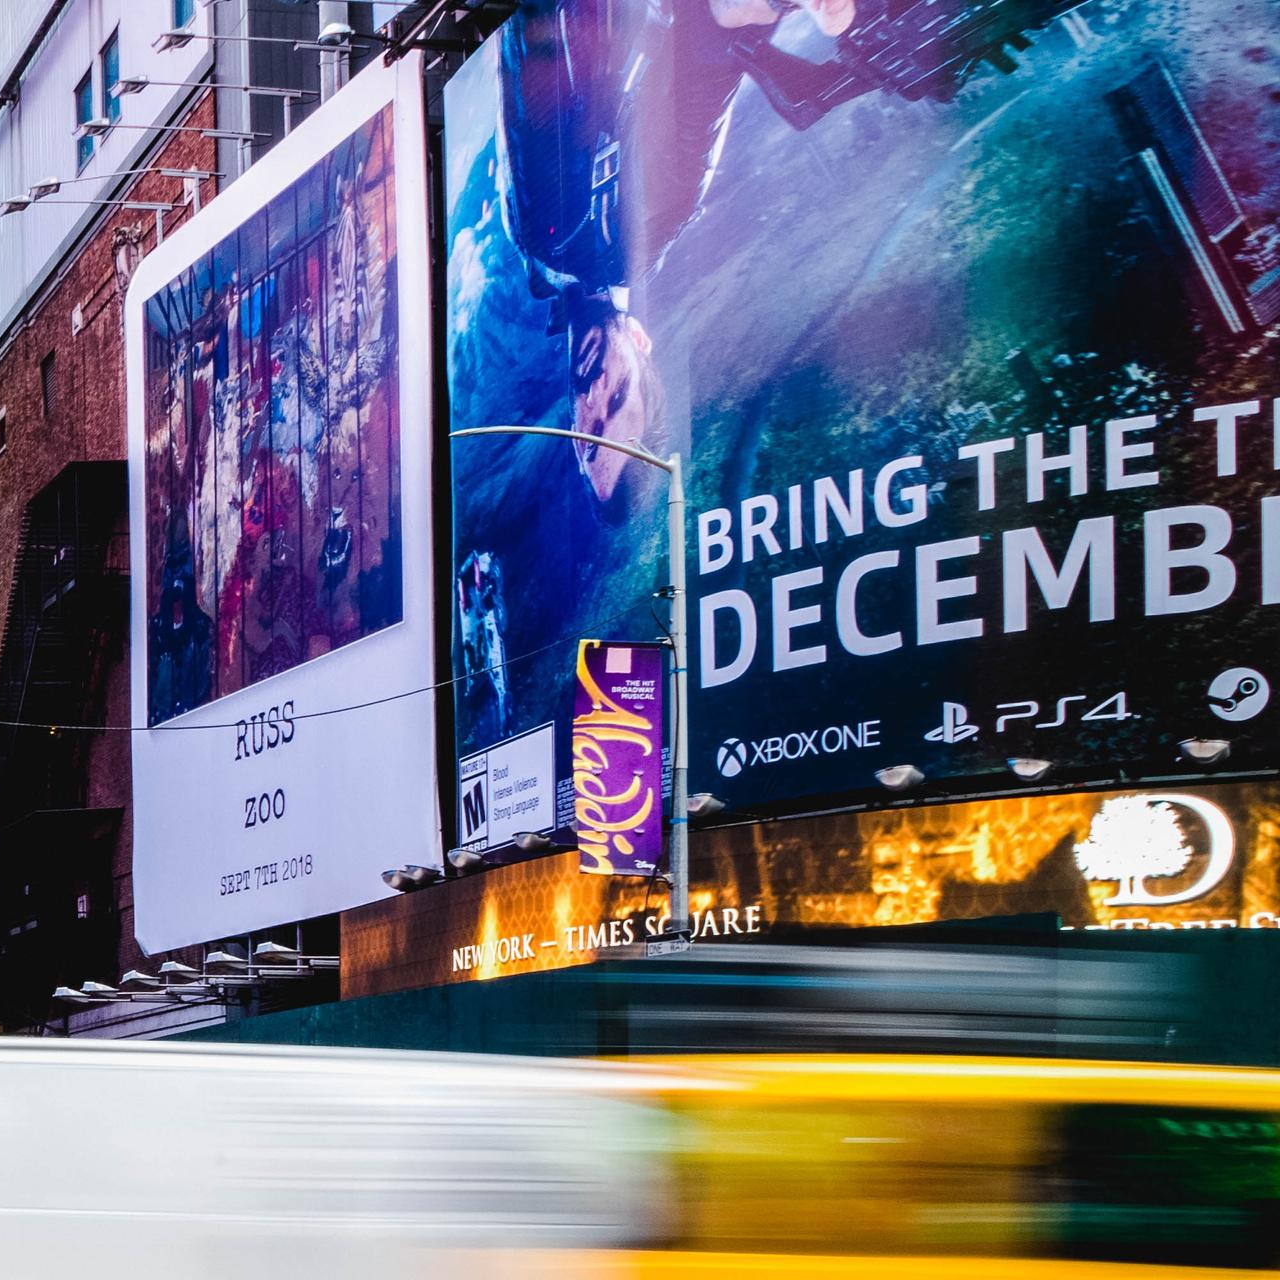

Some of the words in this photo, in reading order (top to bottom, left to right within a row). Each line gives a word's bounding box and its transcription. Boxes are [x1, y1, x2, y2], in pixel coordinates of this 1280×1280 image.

[698, 456, 930, 575] BRING
[958, 415, 1160, 511] THE
[1193, 395, 1280, 477] T
[234, 700, 295, 762] RUSS
[995, 691, 1131, 732] PS4
[572, 638, 654, 875] Aladdin
[750, 729, 821, 766] XBOX
[822, 720, 881, 754] ONE
[493, 765, 509, 782] Blood
[493, 785, 513, 801] Intense
[513, 776, 538, 793] Violence
[244, 788, 285, 829] ZOO
[463, 780, 486, 838] M
[493, 805, 511, 821] Strong
[512, 796, 540, 815] Language
[220, 867, 251, 896] SEPT
[254, 862, 278, 890] 7TH
[283, 854, 313, 881] 2018
[452, 945, 485, 971] NEW
[484, 934, 535, 964] YORK
[564, 919, 634, 951] TIMES
[649, 943, 663, 955] ONE
